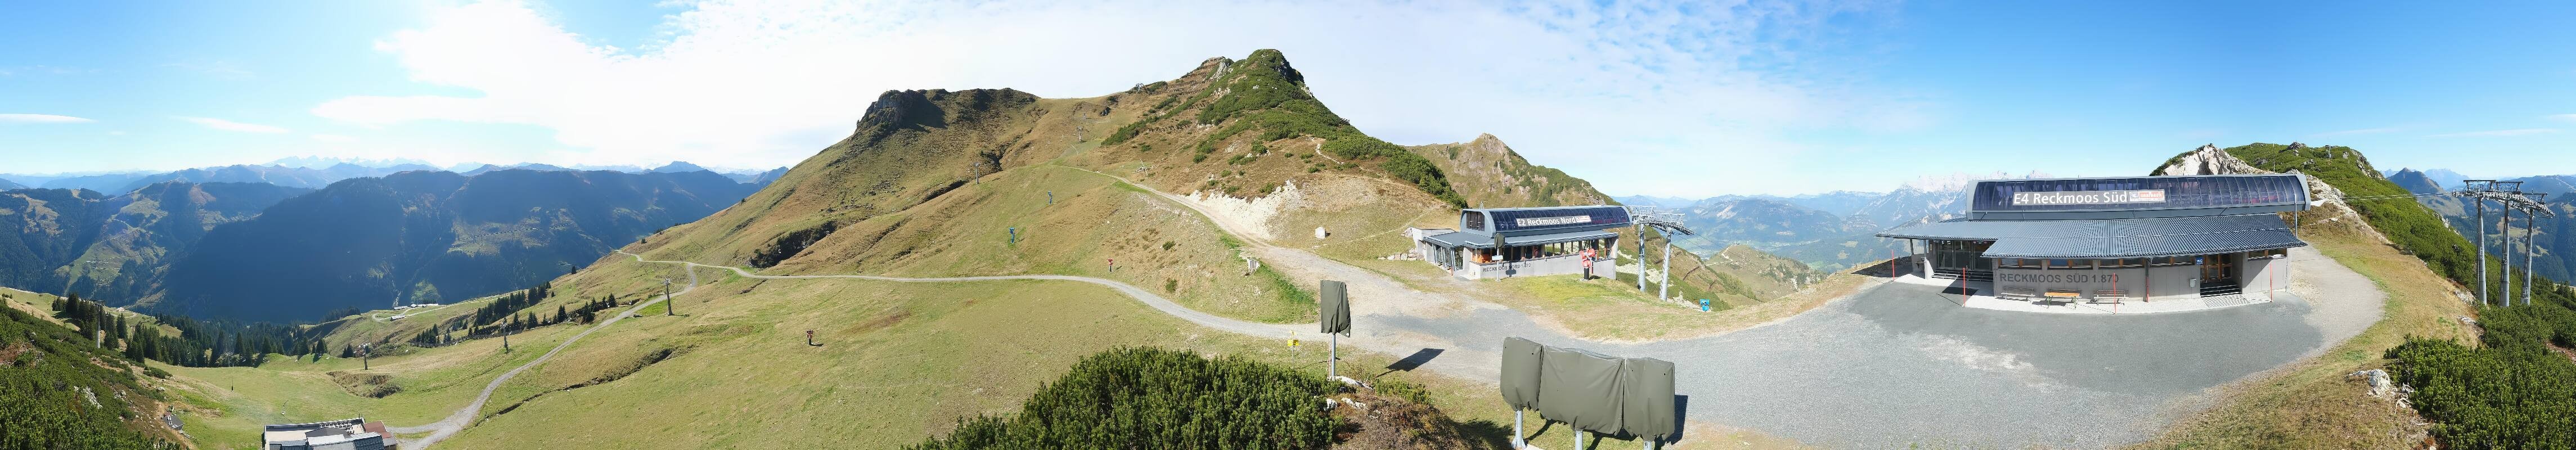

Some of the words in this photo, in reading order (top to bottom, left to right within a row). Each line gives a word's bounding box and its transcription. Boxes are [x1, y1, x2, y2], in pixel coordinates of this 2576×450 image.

[2014, 193, 2029, 204] E4
[2034, 192, 2099, 204] Reckmoos
[2104, 191, 2127, 203] Süd
[2000, 273, 2061, 283] RECKMOOS
[2066, 273, 2088, 283] SÜD
[2092, 274, 2119, 283] 1.870
